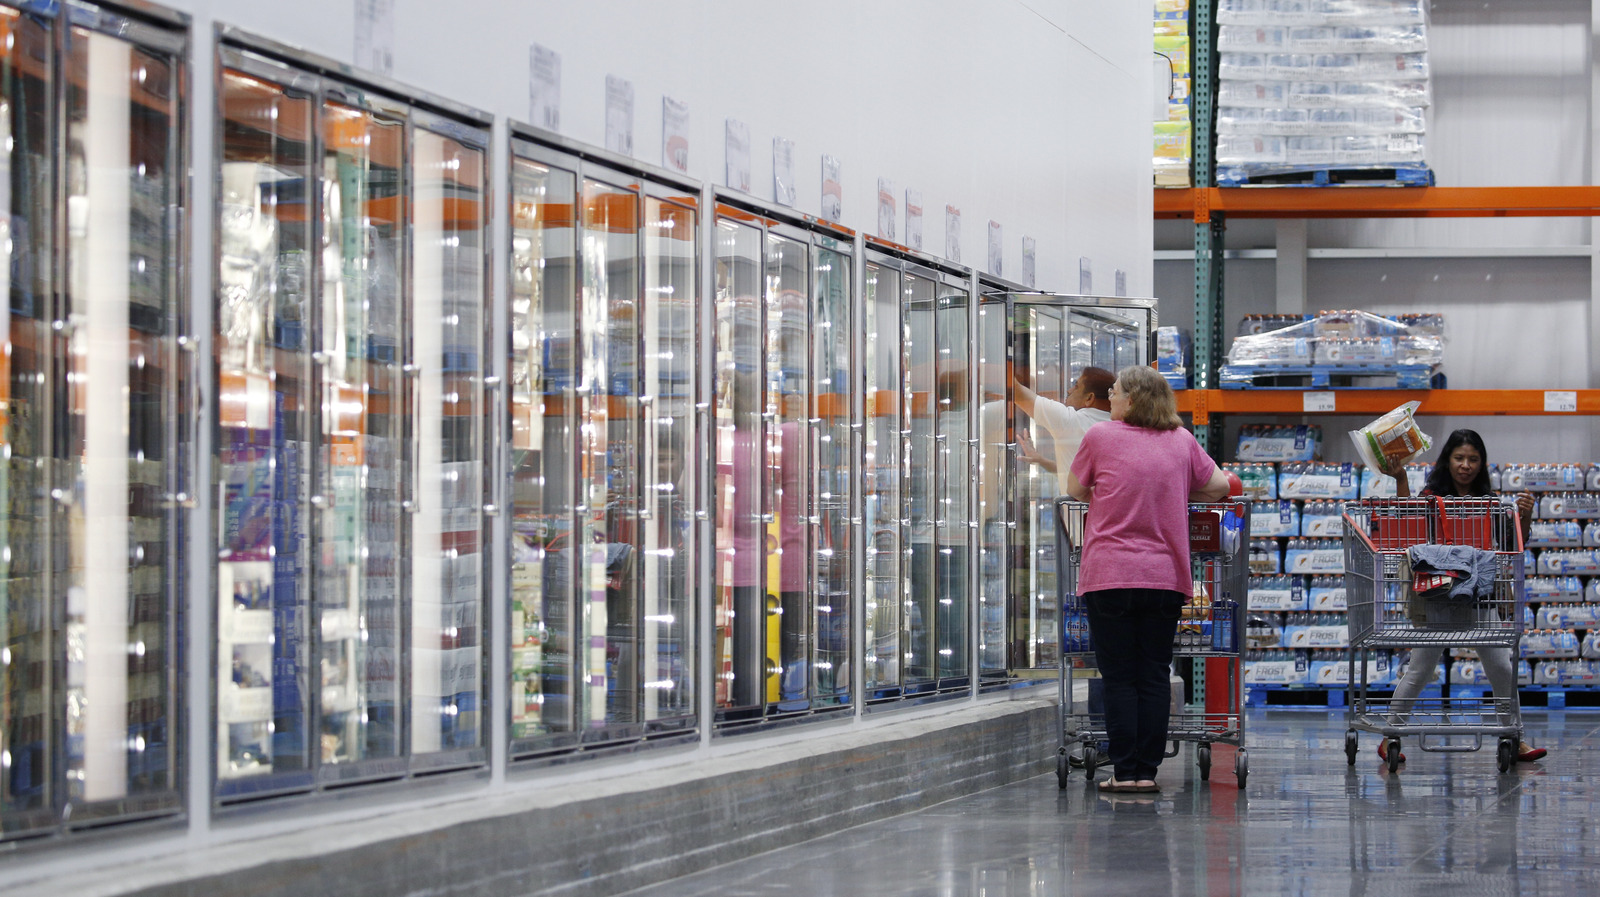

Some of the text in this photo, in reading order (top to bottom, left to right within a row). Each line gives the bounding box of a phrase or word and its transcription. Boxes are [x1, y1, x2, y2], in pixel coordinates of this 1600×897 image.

[1312, 553, 1344, 564] FROST
[1251, 594, 1282, 604] FROST
[1309, 630, 1340, 640] FROST
[1255, 665, 1287, 675] FROST
